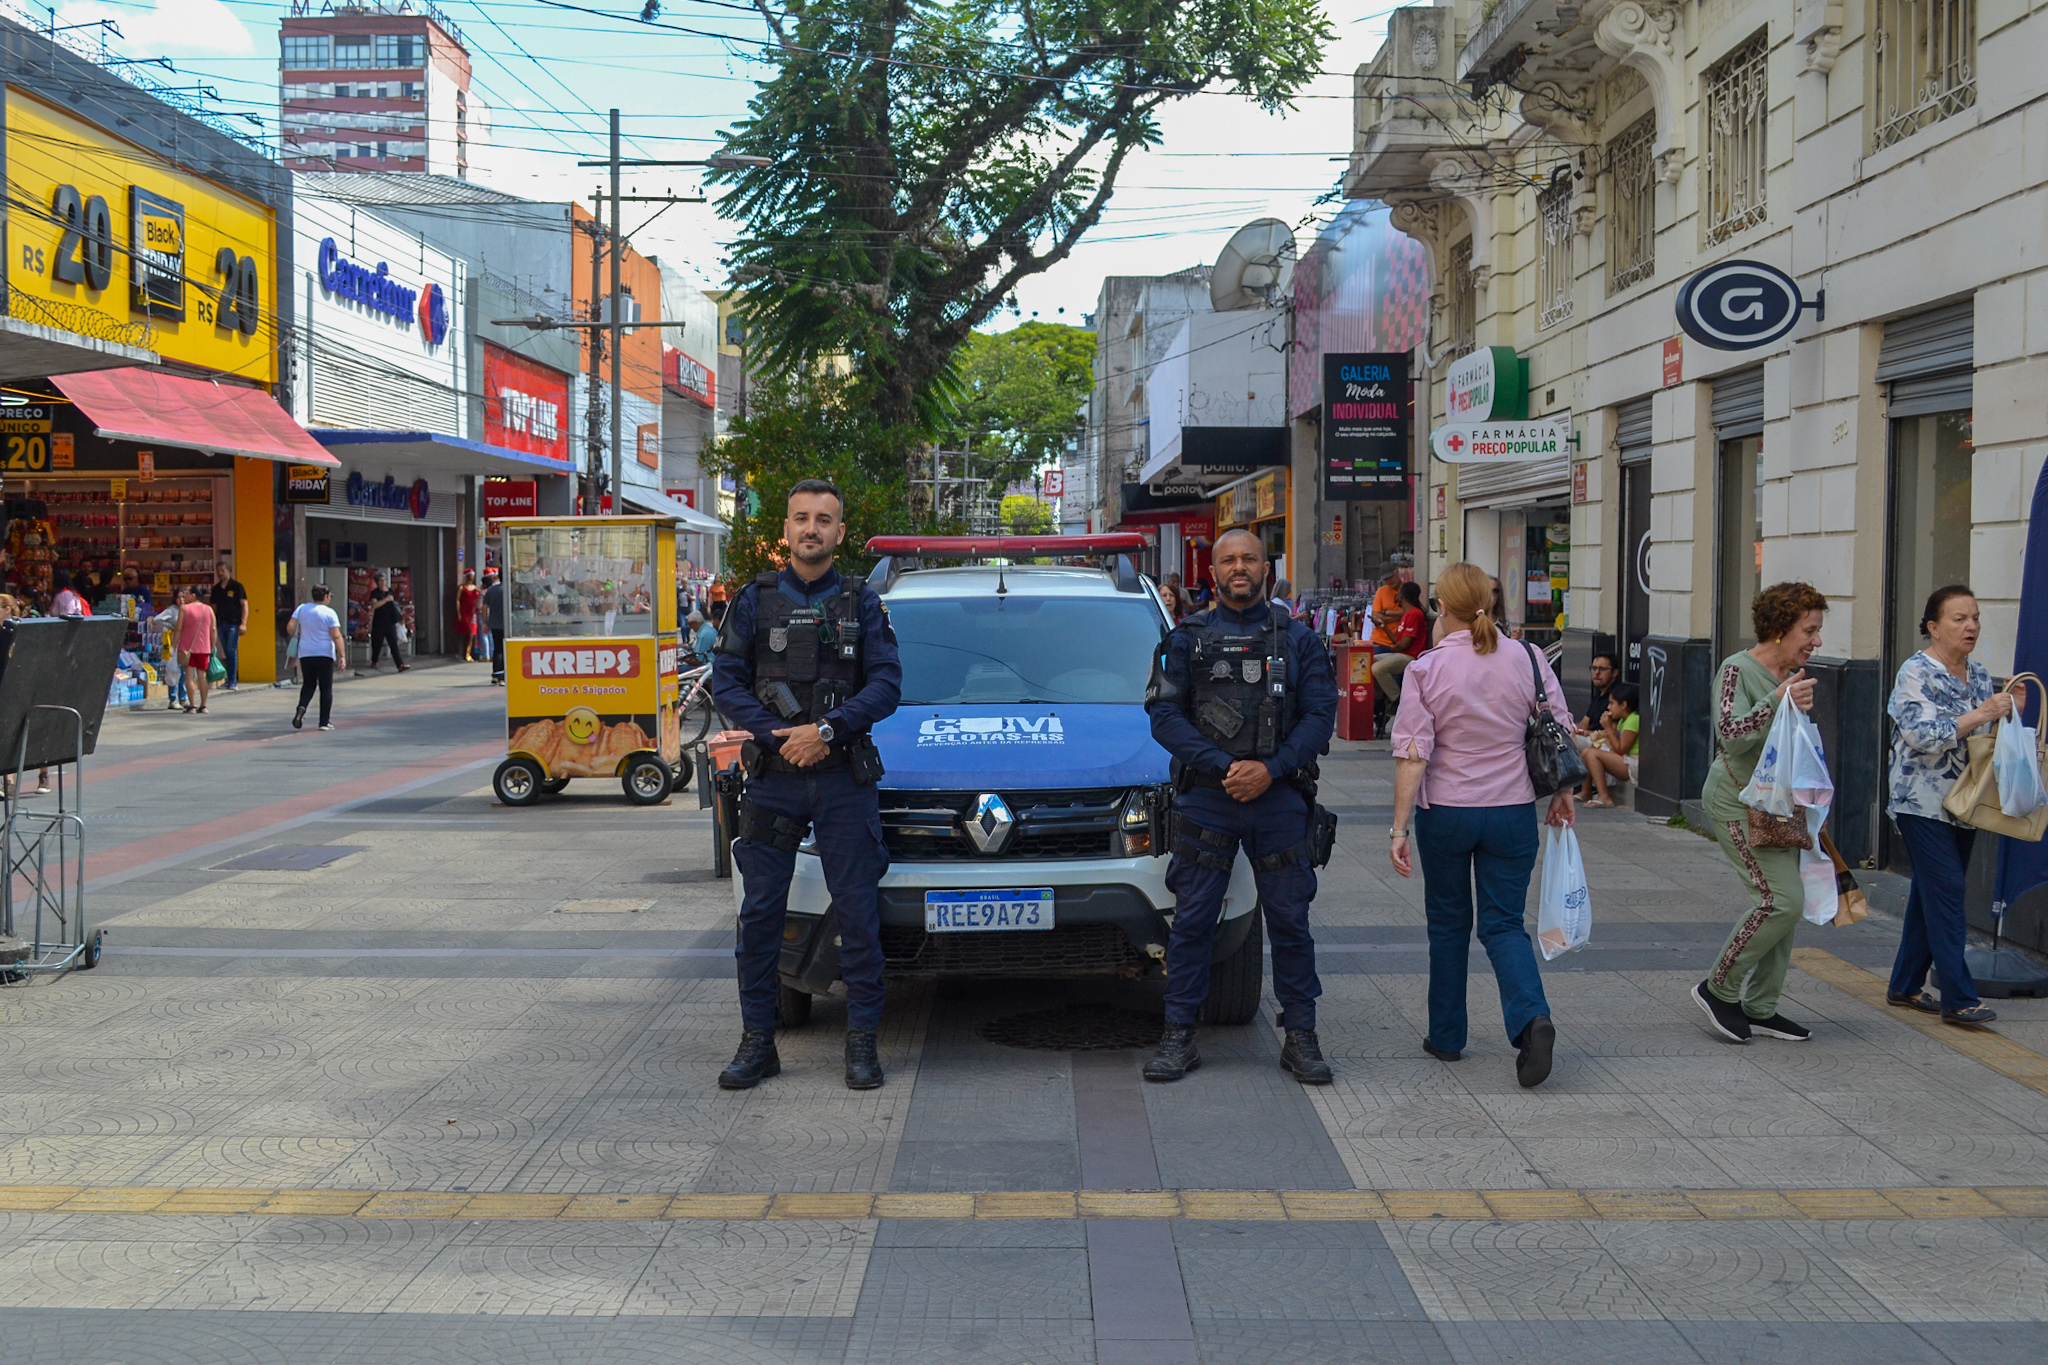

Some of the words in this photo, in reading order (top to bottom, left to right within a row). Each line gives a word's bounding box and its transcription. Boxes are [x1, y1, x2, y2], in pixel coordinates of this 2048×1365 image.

[23, 244, 45, 277] R$
[52, 184, 112, 291] 20
[146, 221, 175, 246] Black
[142, 248, 182, 283] FRIDAY
[318, 237, 417, 324] Carrefour
[198, 300, 213, 326] R$
[215, 247, 259, 336] 20
[1340, 365, 1391, 381] GALERIA
[1458, 362, 1490, 388] FARMÁCIA
[1345, 382, 1386, 400] Moda
[0, 408, 43, 419] PREÇO
[501, 386, 531, 433] TOP
[530, 396, 559, 441] LINE
[1332, 402, 1399, 419] INDIVIDUAL
[1472, 425, 1556, 440] FARMÁCIA
[7, 436, 46, 470] 20
[292, 467, 319, 478] Black
[289, 479, 327, 491] FRIDAY
[486, 496, 508, 506] TOP
[510, 496, 533, 506] LINE
[531, 649, 631, 676] KREPS
[539, 685, 570, 695] Doces
[572, 685, 579, 695] &
[582, 685, 627, 696] Salgados
[916, 740, 968, 748] PREVENÇÃO
[917, 732, 1064, 744] PELOTAS-RS
[936, 902, 1040, 927] REE9A73
[928, 923, 937, 931] BR
